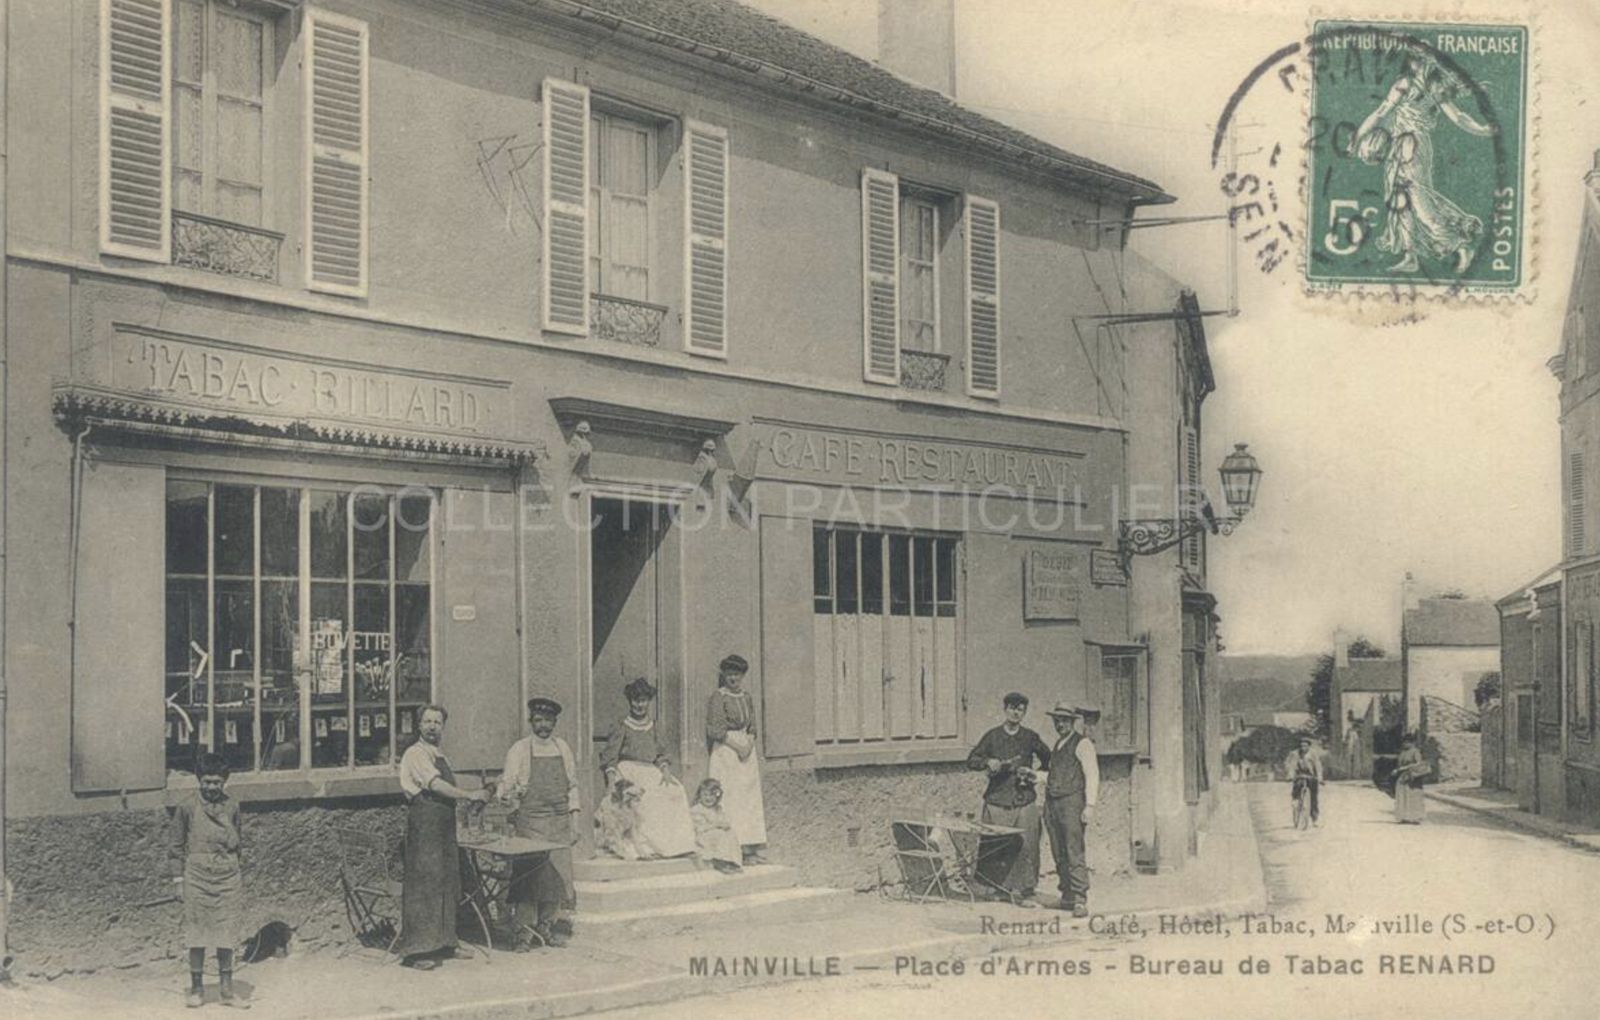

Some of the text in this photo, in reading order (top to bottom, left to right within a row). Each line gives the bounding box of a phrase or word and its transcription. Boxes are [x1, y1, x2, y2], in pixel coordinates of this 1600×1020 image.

[1436, 34, 1519, 56] FRANÇAISE
[1492, 185, 1514, 272] POSTES
[126, 338, 481, 433] TABAC BILLARD
[876, 439, 1072, 490] RESTAURANT
